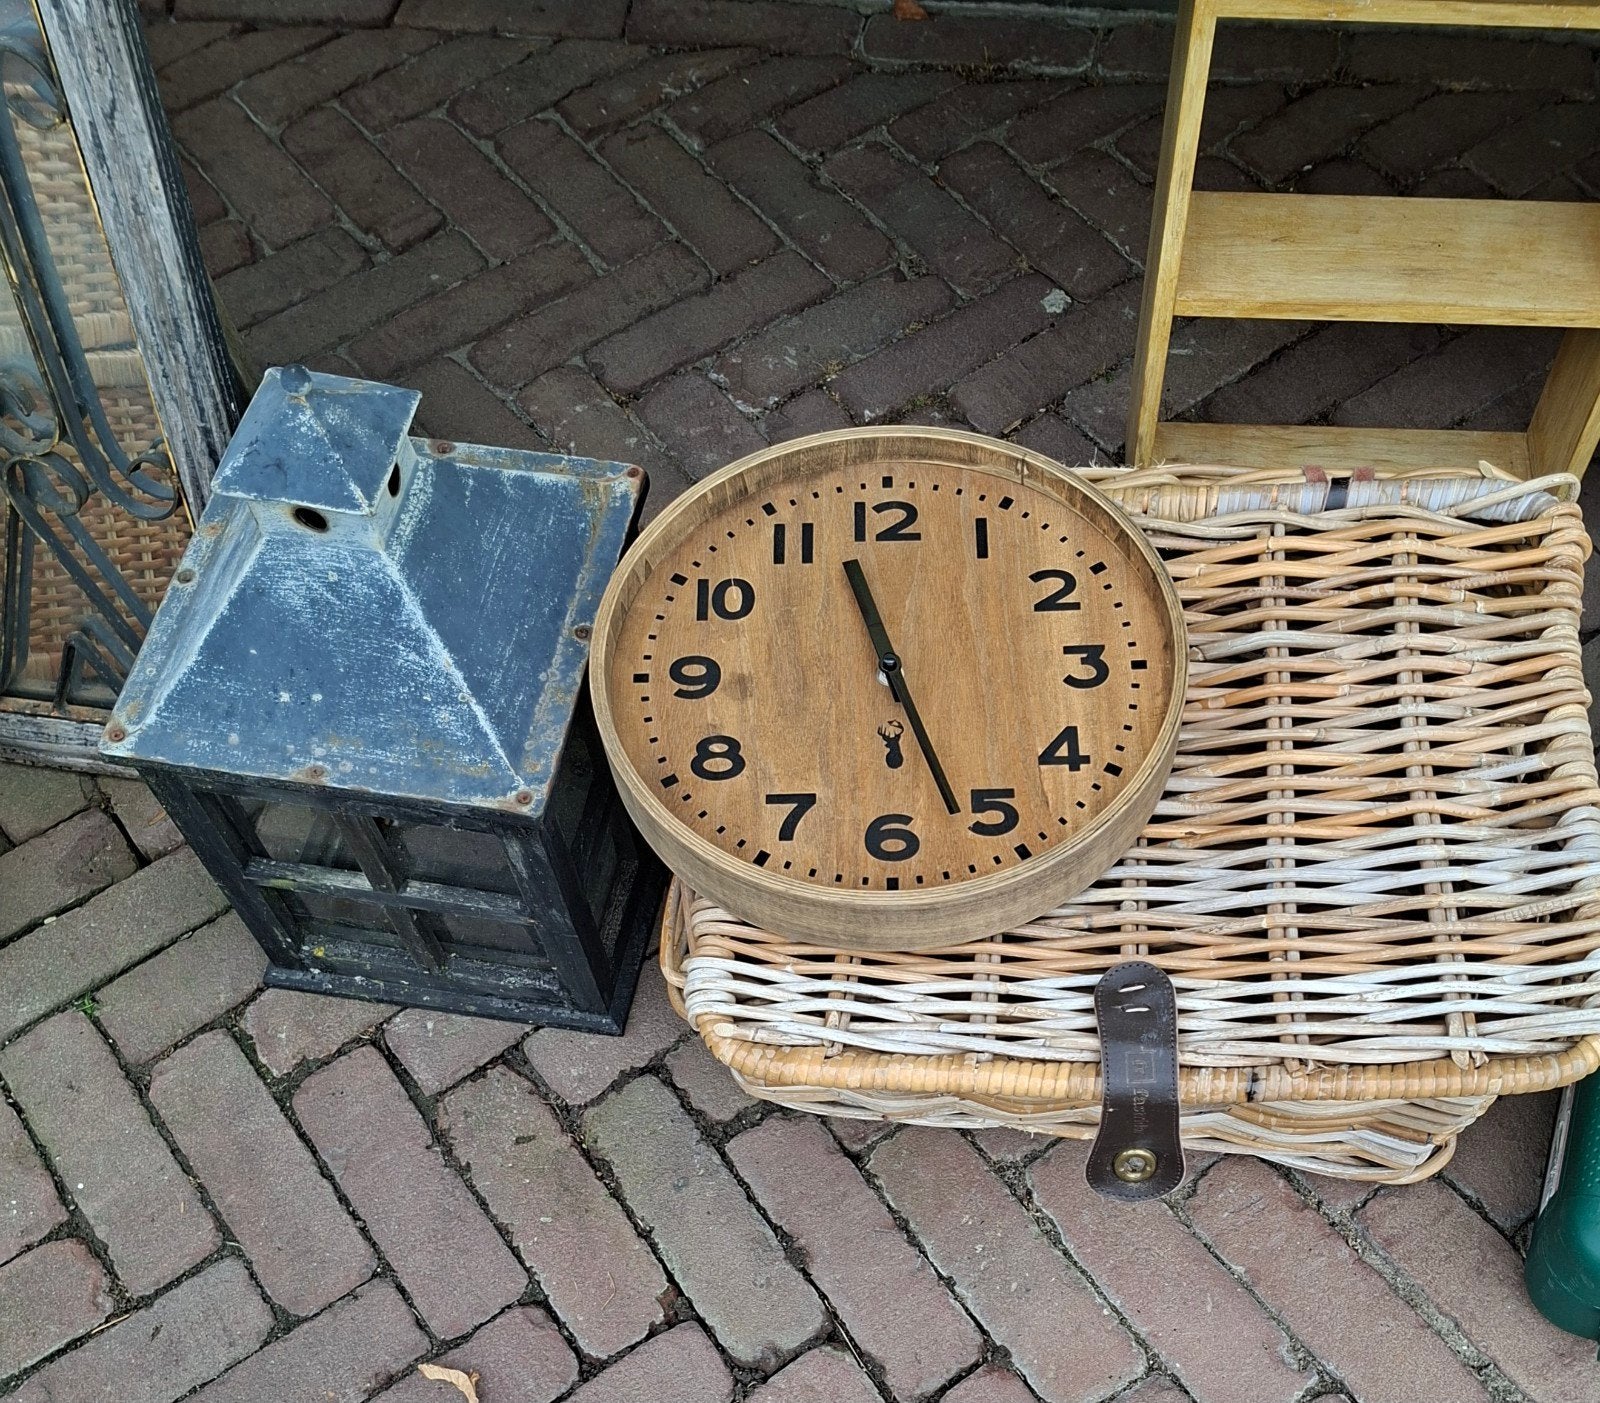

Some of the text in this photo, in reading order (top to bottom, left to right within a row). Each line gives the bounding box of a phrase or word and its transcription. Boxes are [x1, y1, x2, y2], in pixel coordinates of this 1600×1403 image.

[774, 523, 813, 564] 11
[855, 501, 921, 542] 12
[976, 518, 988, 558] 1
[696, 578, 756, 621] 10
[1028, 569, 1081, 612] 2
[669, 656, 722, 700] 9
[1063, 644, 1110, 689] 3
[690, 735, 746, 781] 8
[1037, 725, 1091, 772] 4
[765, 793, 817, 842] 7
[968, 788, 1020, 837] 5
[864, 814, 920, 862] 6
